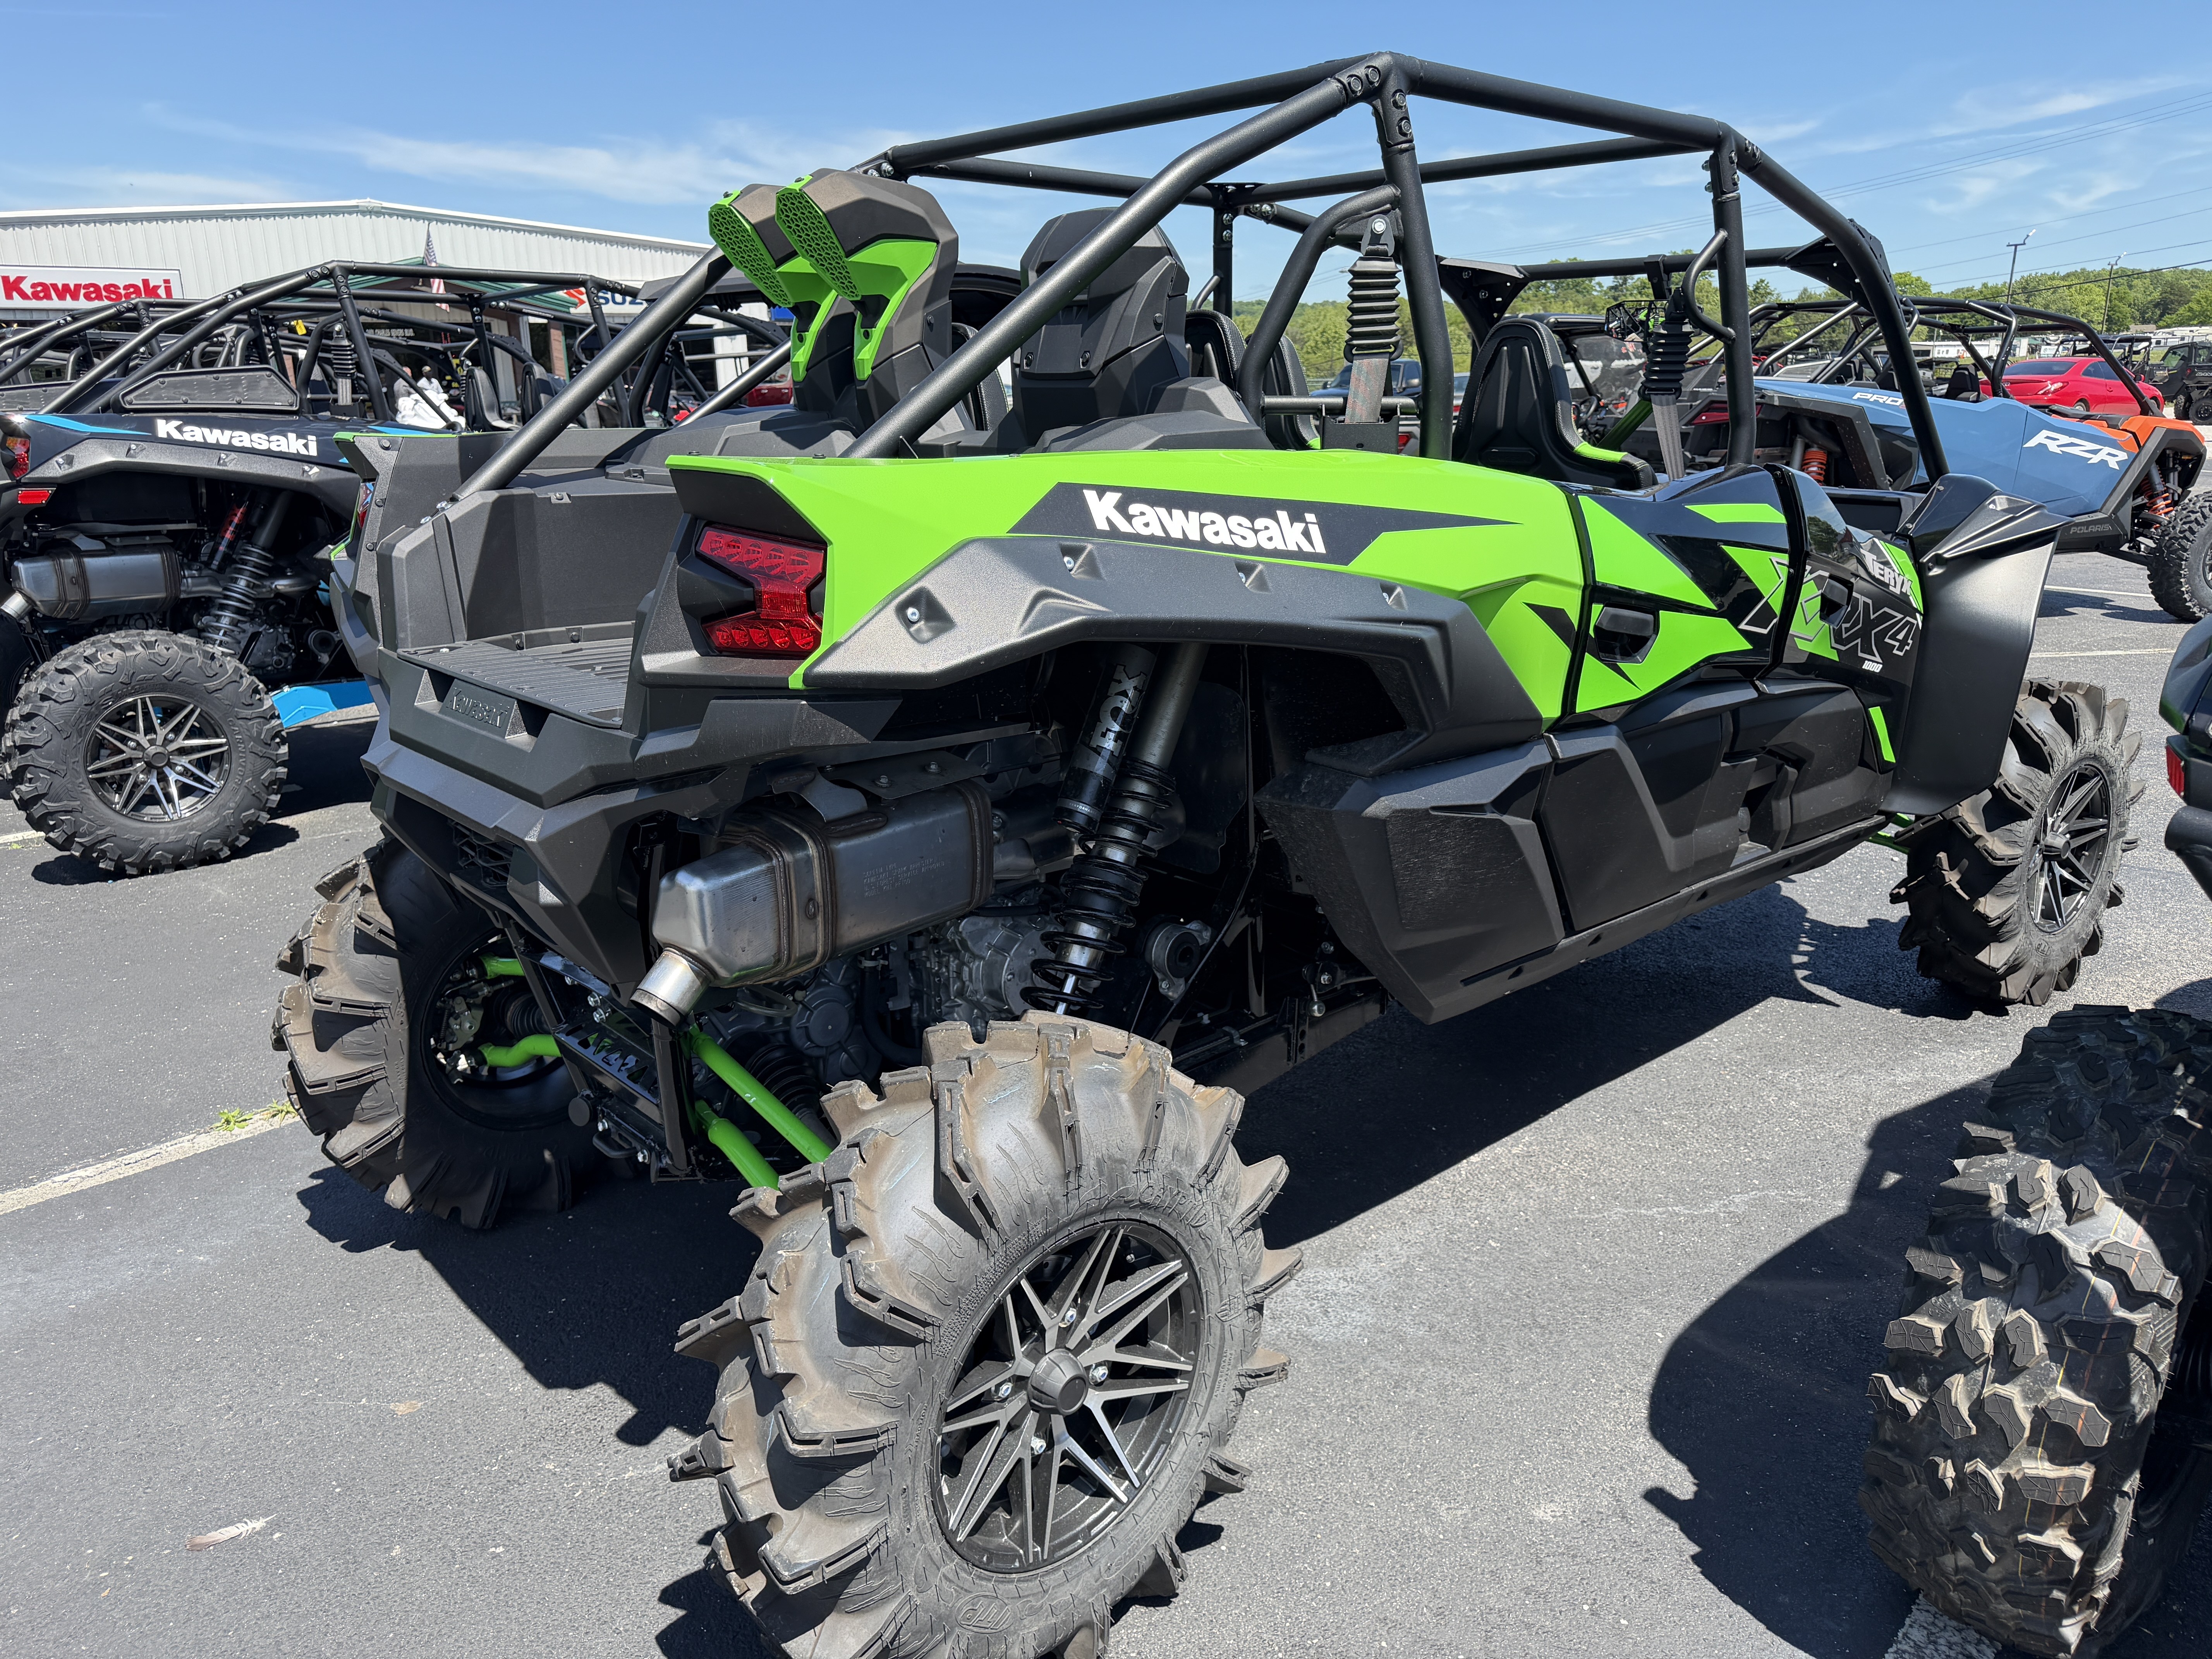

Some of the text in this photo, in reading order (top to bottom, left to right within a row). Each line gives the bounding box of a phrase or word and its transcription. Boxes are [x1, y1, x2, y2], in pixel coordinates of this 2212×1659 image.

[1, 275, 173, 302] Kawasaki
[1852, 392, 1904, 405] PRO
[156, 419, 318, 457] Kawasaki
[2023, 429, 2128, 470] RZR
[1083, 489, 1326, 554] Kawasaki
[2070, 524, 2110, 534] POLARIS
[1860, 548, 1912, 595] TERYX
[1862, 660, 1882, 673] 1000
[445, 687, 510, 728] Kawasaki
[1089, 663, 1147, 757] FOX
[227, 717, 246, 793] CARNIVORE
[1214, 1379, 1222, 1398] ONLY
[958, 1600, 1010, 1630] ITP
